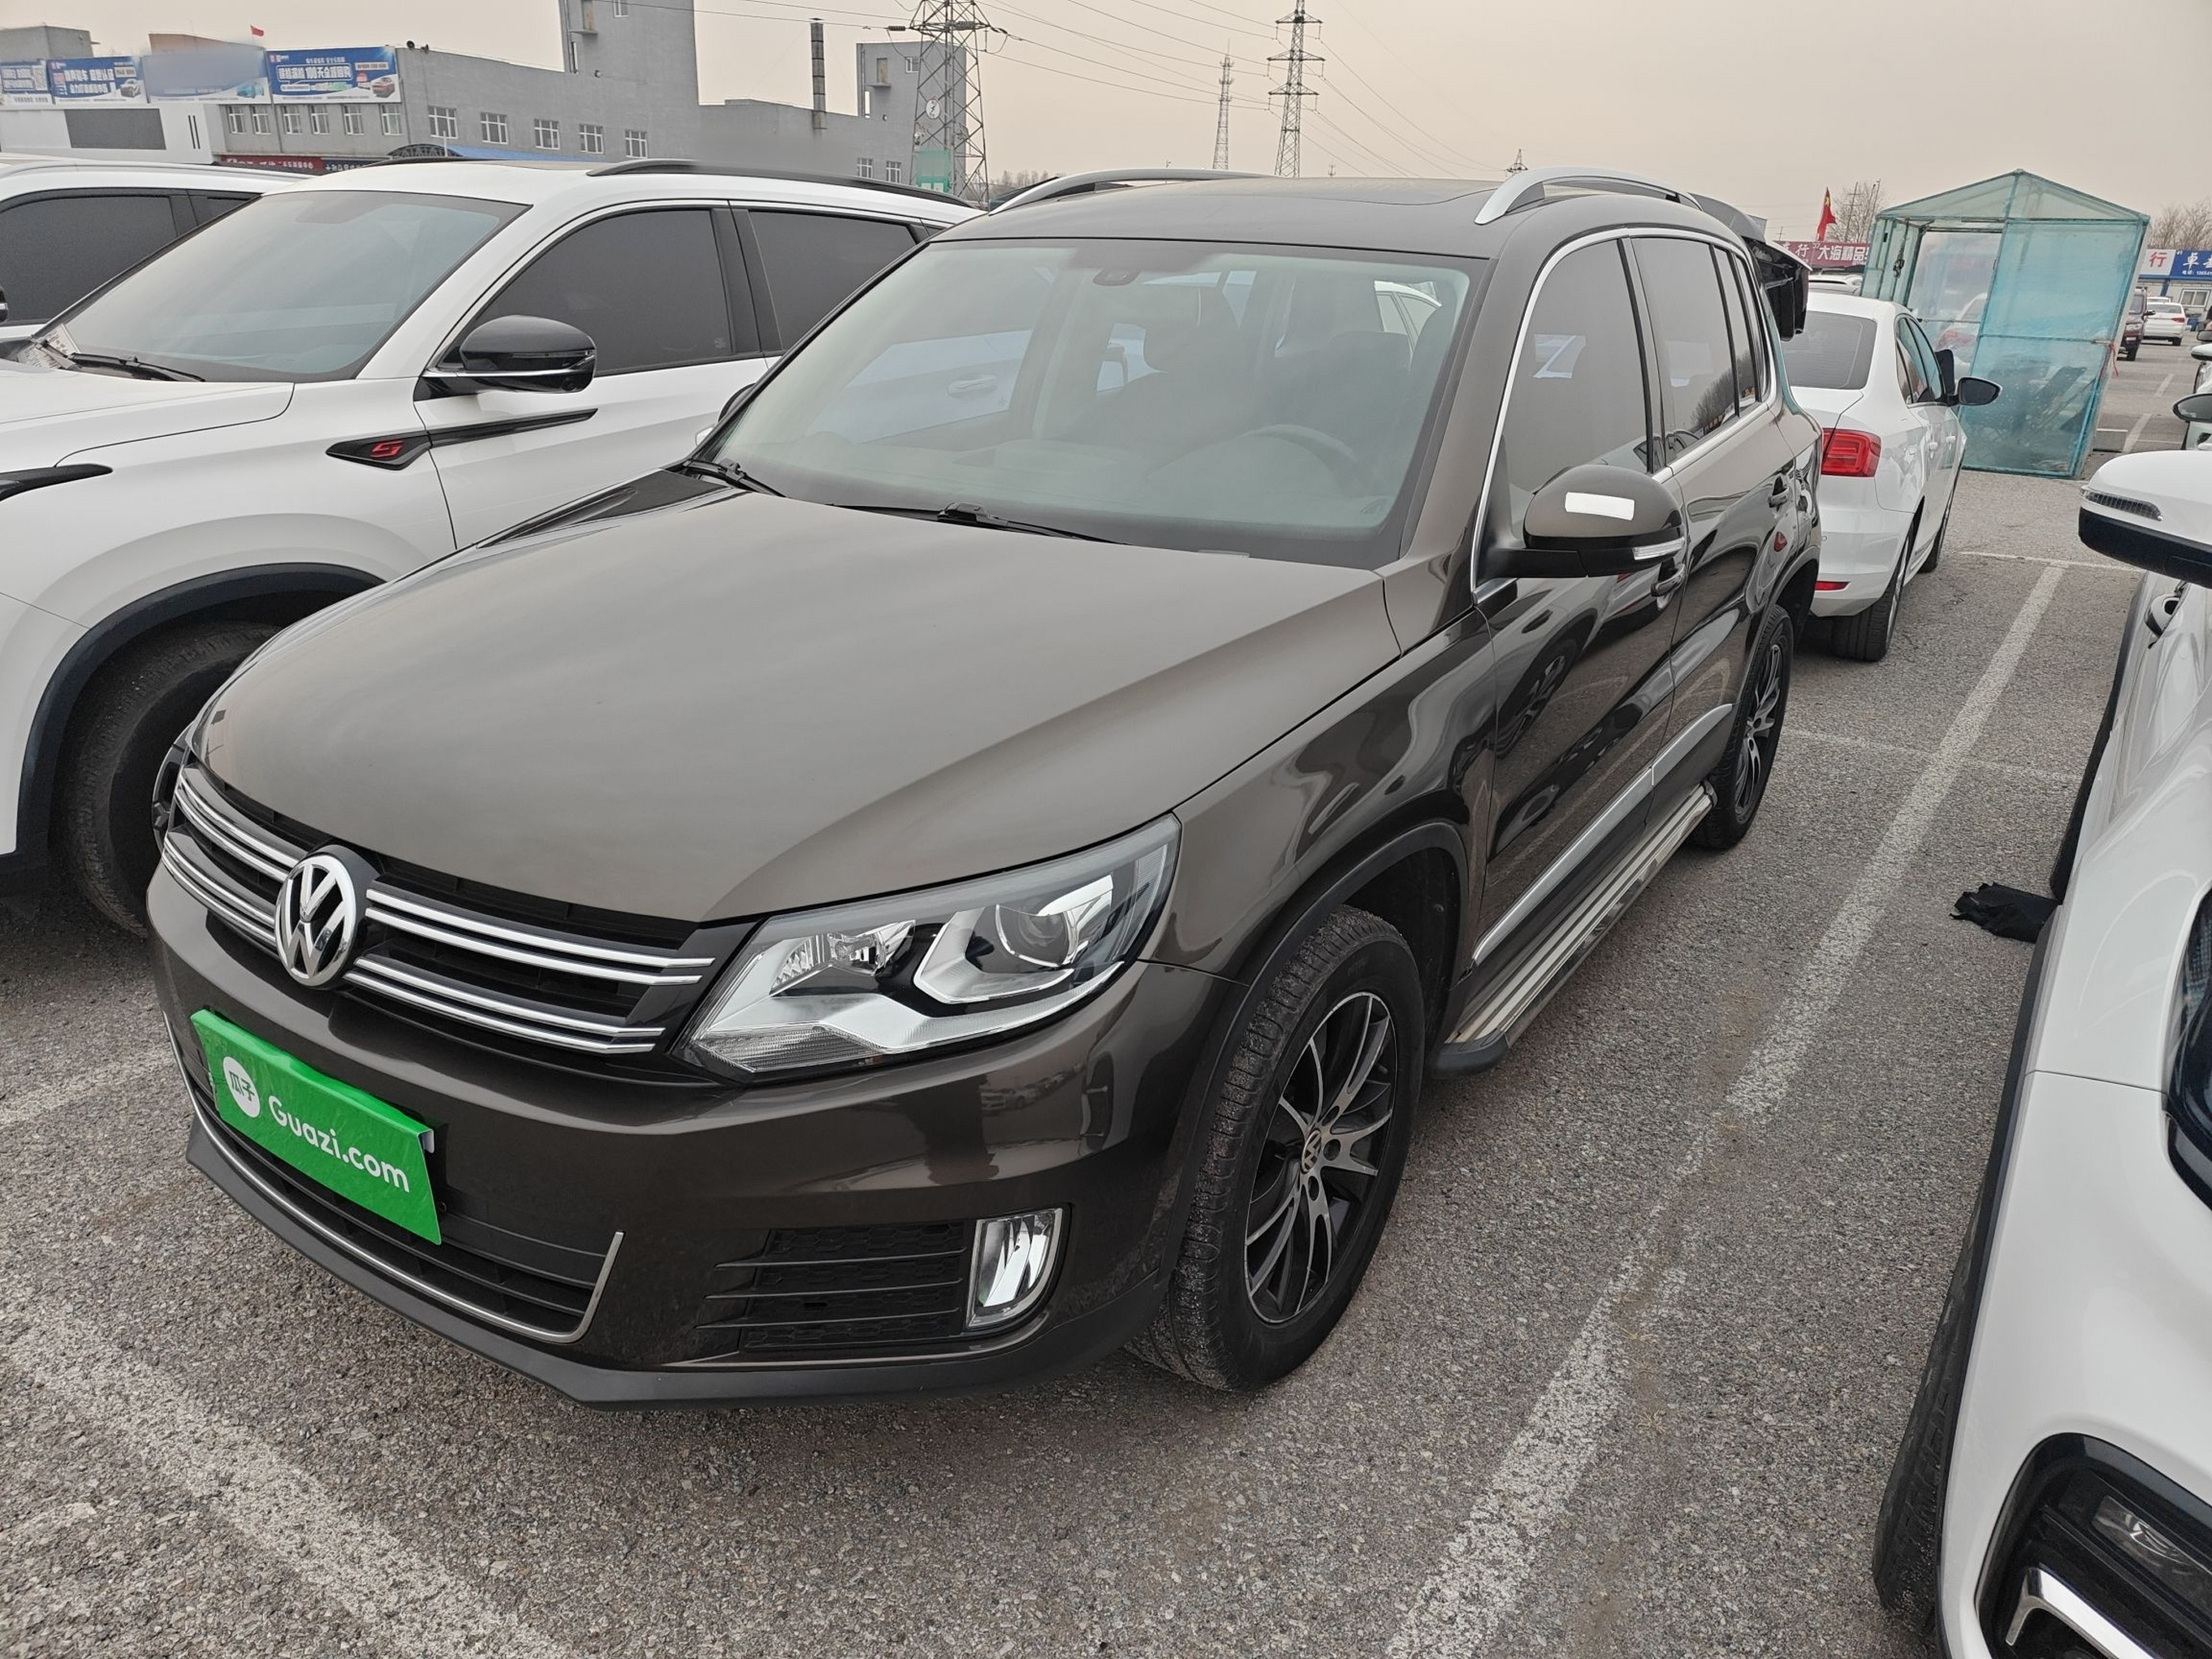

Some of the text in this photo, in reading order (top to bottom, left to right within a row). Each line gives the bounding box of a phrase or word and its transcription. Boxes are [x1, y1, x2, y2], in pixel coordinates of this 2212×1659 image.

[1817, 245, 1869, 261] 大海精品
[2149, 252, 2167, 267] 行
[229, 1070, 255, 1102] 瓜子
[268, 1095, 410, 1193] Guazi.com
